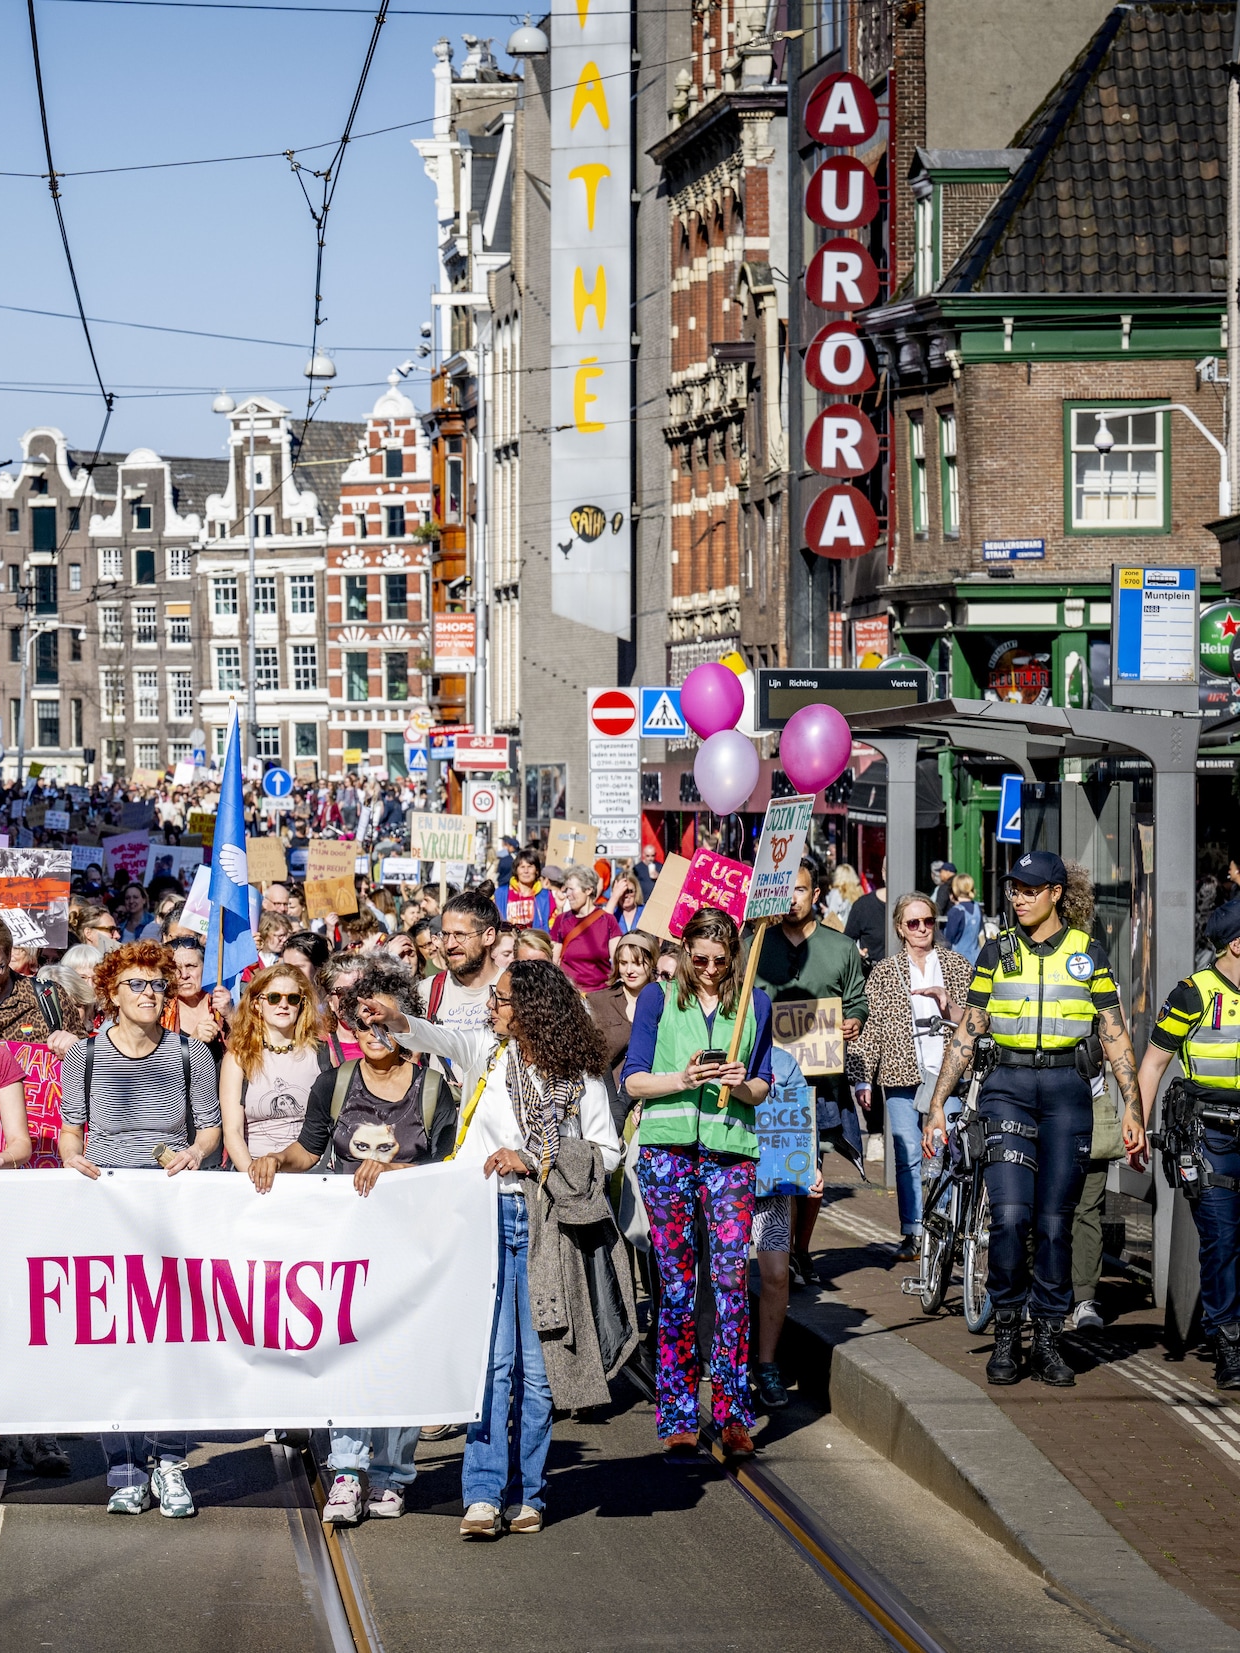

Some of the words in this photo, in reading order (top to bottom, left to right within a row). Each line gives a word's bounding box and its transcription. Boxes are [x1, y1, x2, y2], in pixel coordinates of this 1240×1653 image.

[818, 81, 865, 547] AURORA
[984, 550, 1010, 559] STRAAT
[1144, 591, 1190, 601] Muntplein
[435, 622, 475, 633] SHOPS
[1201, 643, 1230, 655] Hein
[768, 679, 781, 689] Lijn
[788, 679, 818, 689] Richting
[890, 679, 918, 688] Vertrek
[989, 671, 1049, 687] REGULAR
[476, 796, 490, 806] 30
[417, 816, 434, 830] EN
[766, 808, 795, 832] JOIN
[794, 804, 813, 831] THE
[411, 847, 422, 858] DE
[326, 864, 348, 873] RECHT
[757, 870, 793, 887] FEMINIST
[700, 880, 735, 908] THE
[753, 886, 789, 899] ANTI-WAR
[772, 1003, 837, 1038] CTION
[782, 1040, 843, 1068] TALK
[26, 1254, 369, 1351] FEMINIST
